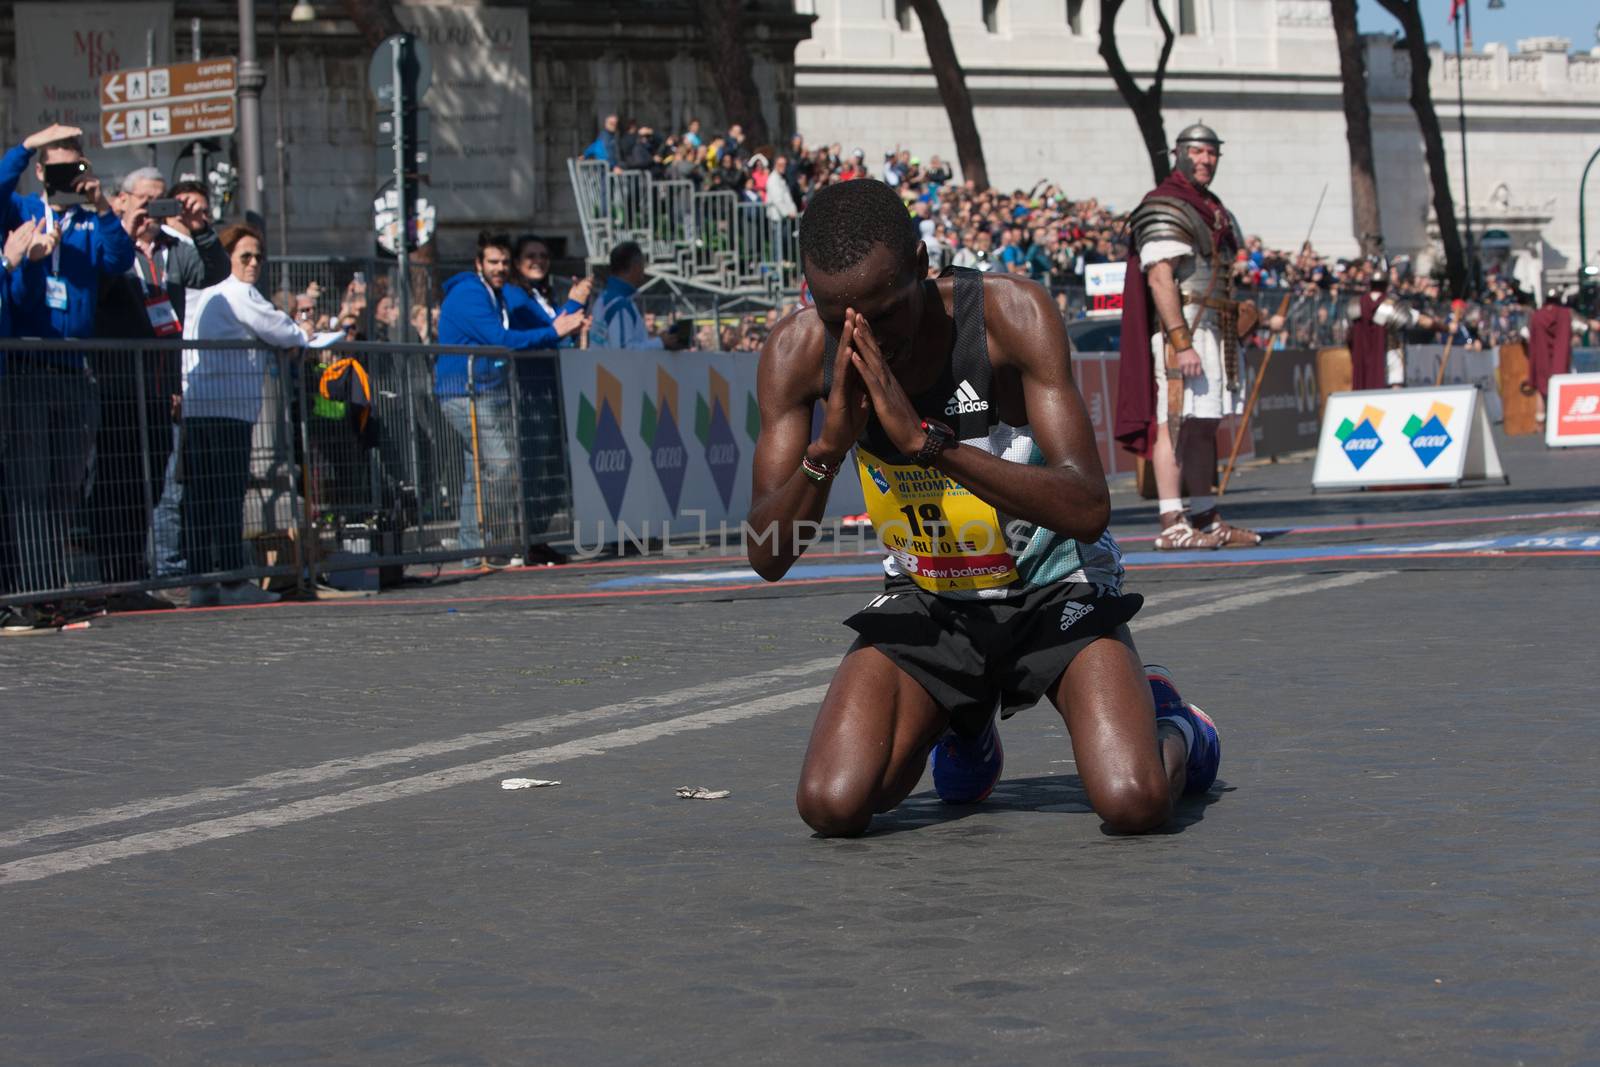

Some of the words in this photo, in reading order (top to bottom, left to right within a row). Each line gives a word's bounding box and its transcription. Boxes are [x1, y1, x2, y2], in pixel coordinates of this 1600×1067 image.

[944, 399, 989, 416] adidas
[1344, 438, 1379, 451] acea
[1412, 434, 1449, 448] acea
[595, 449, 627, 473] acea
[656, 446, 683, 469] acea
[898, 481, 910, 493] di
[912, 479, 954, 492] ROMA
[900, 503, 947, 538] 18
[922, 568, 949, 578] new
[951, 564, 1008, 578] balance
[949, 580, 957, 588] A
[1059, 602, 1095, 632] adidas
